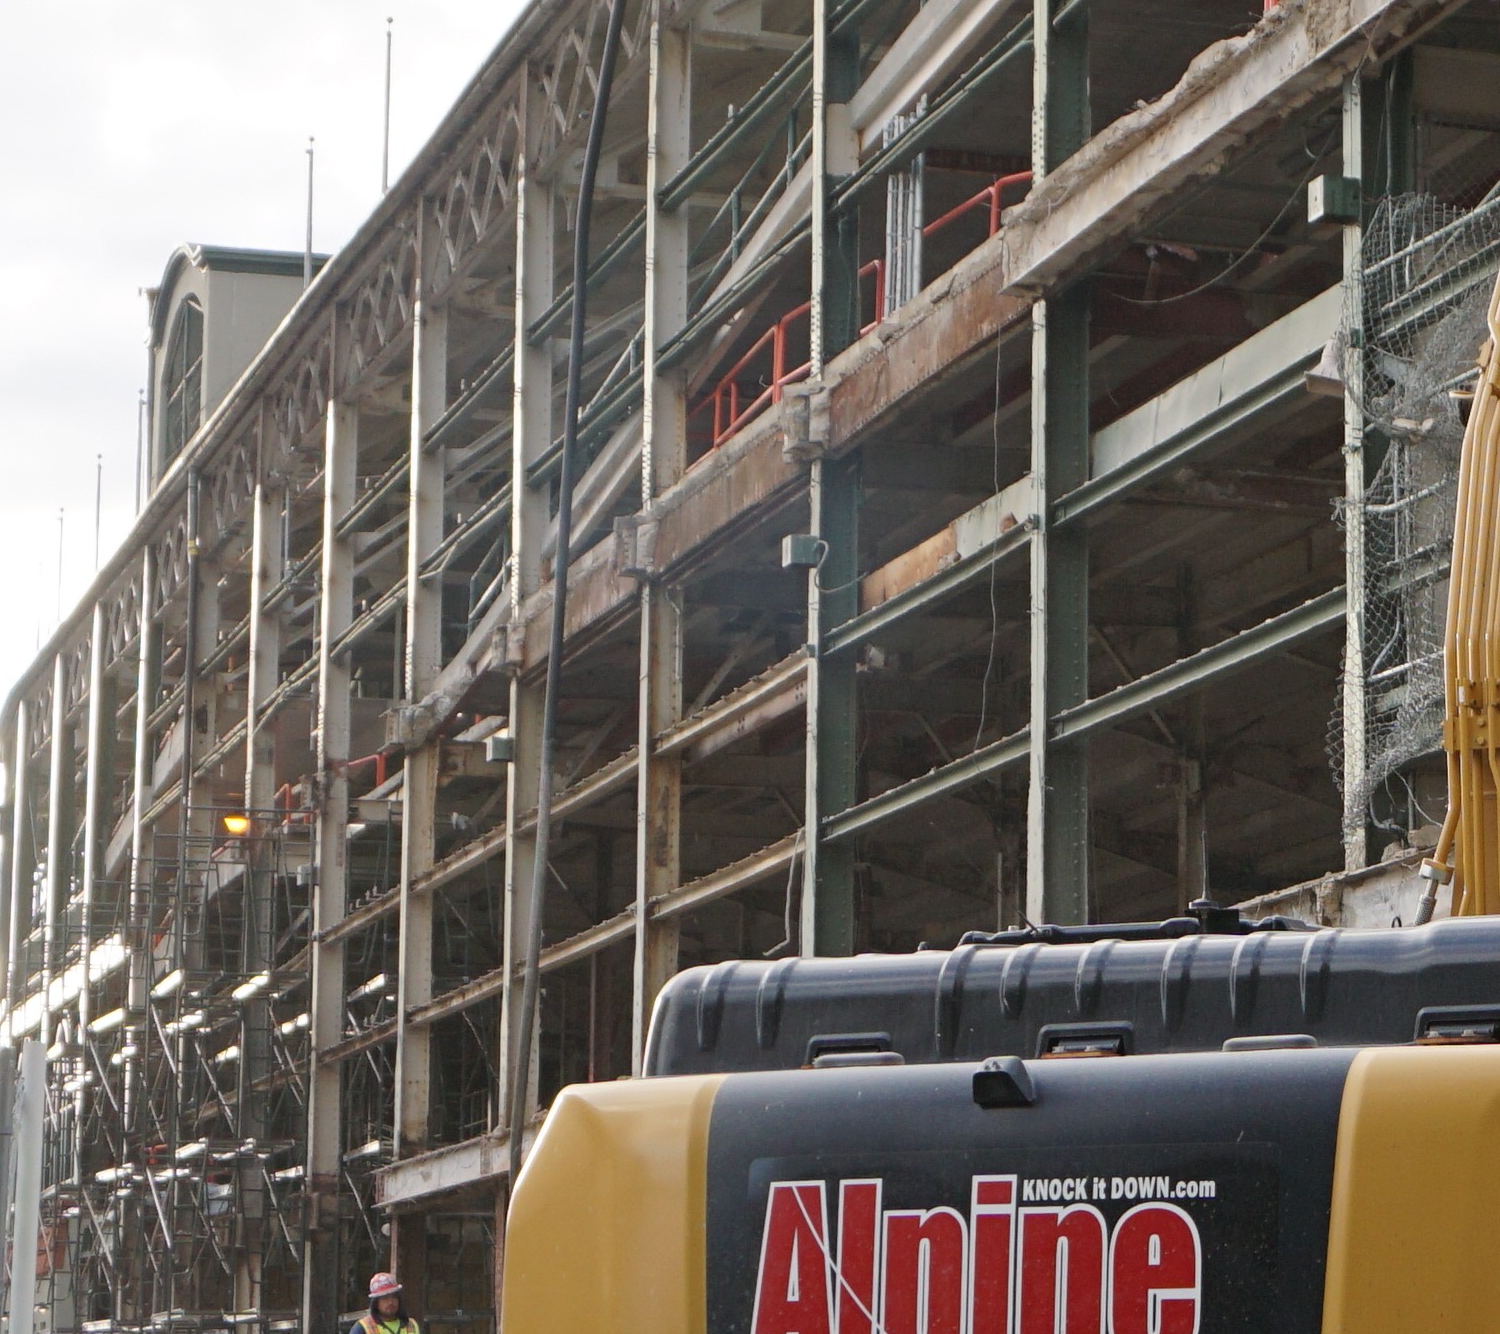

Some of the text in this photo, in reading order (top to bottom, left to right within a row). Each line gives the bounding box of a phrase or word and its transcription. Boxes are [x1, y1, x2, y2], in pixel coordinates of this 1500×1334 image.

[1023, 1176, 1216, 1201] KNOCK it DOWN.com
